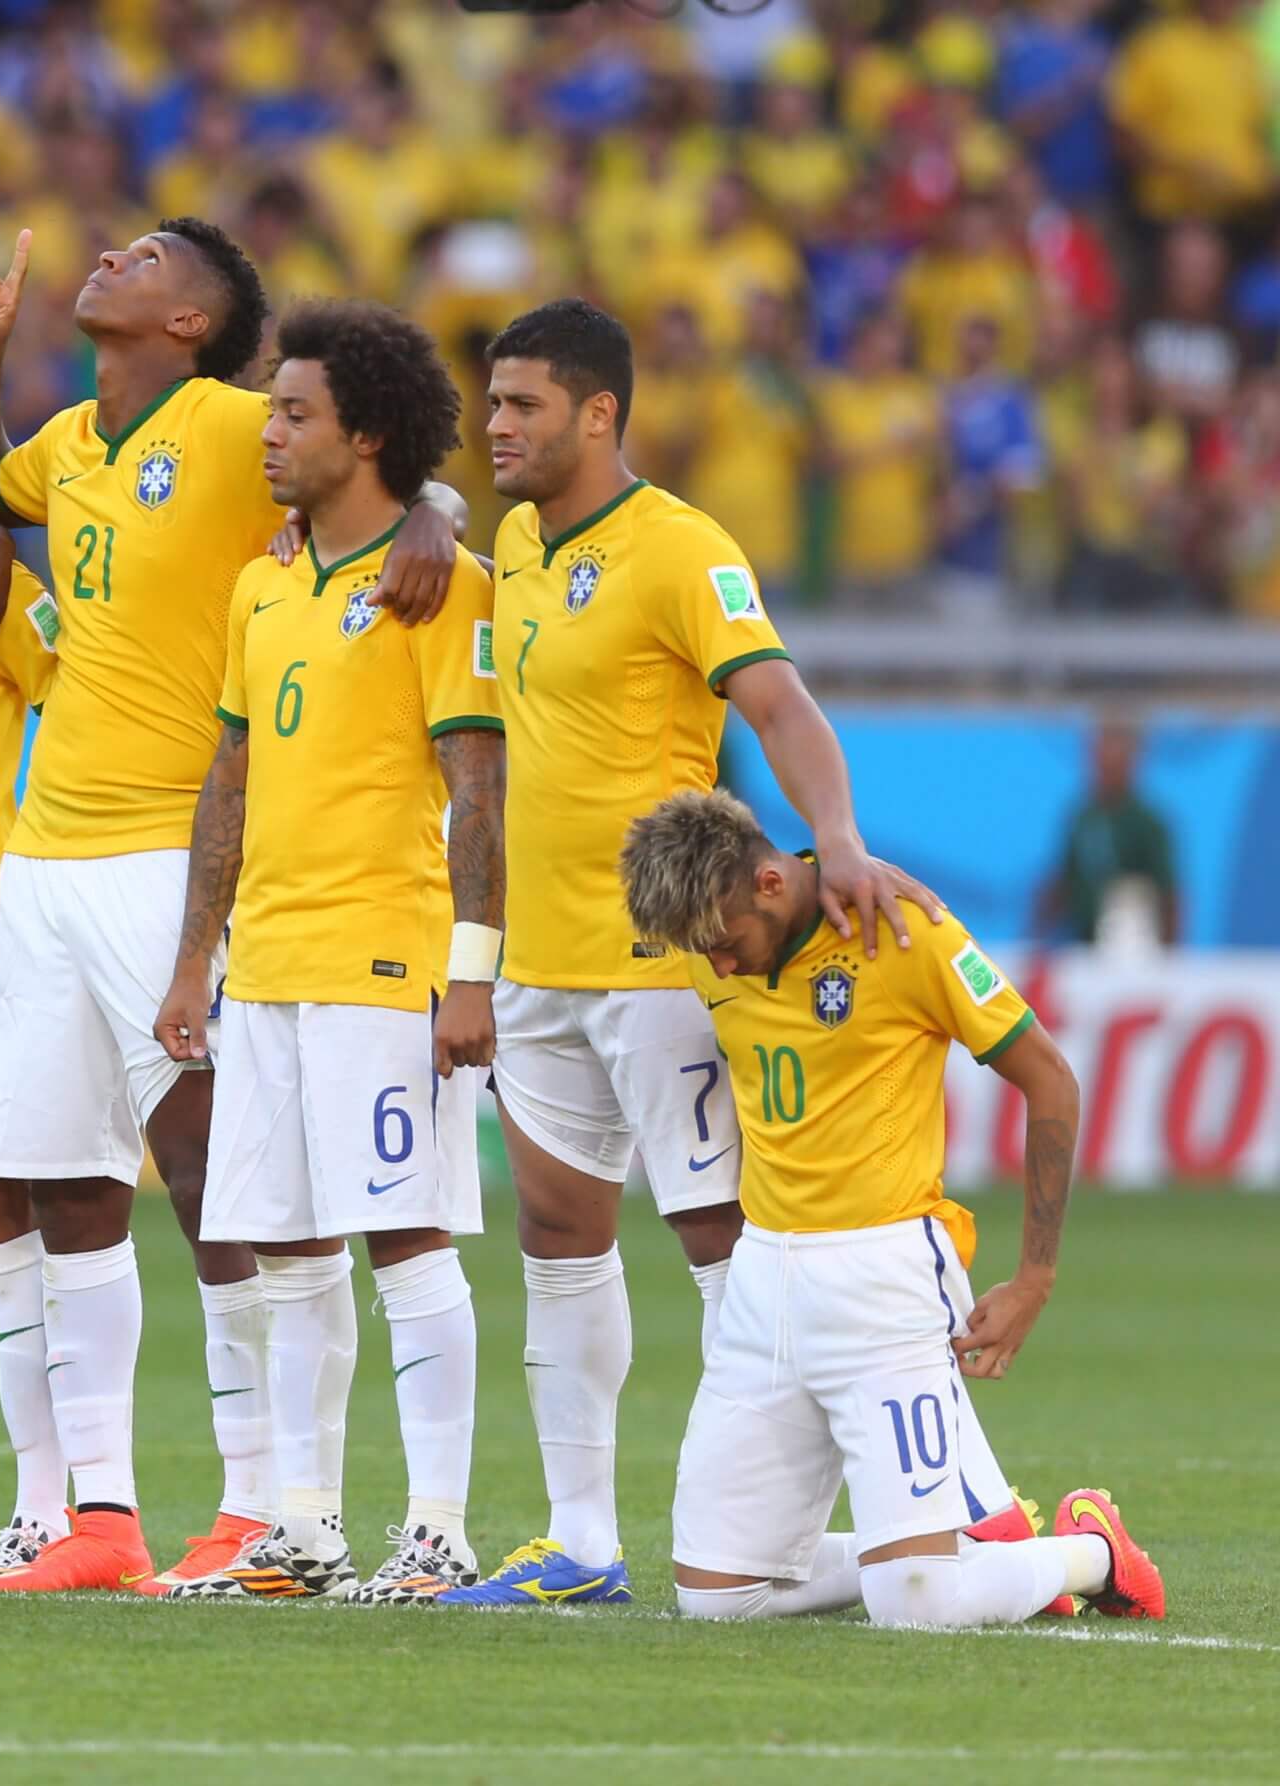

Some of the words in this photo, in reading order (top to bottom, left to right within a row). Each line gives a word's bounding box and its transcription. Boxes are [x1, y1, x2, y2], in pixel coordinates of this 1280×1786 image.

[73, 525, 114, 601] 21
[517, 619, 539, 696] 7
[275, 661, 307, 738] 6
[680, 1060, 718, 1142] 7
[752, 1044, 805, 1124] 10
[373, 1085, 413, 1164] 6
